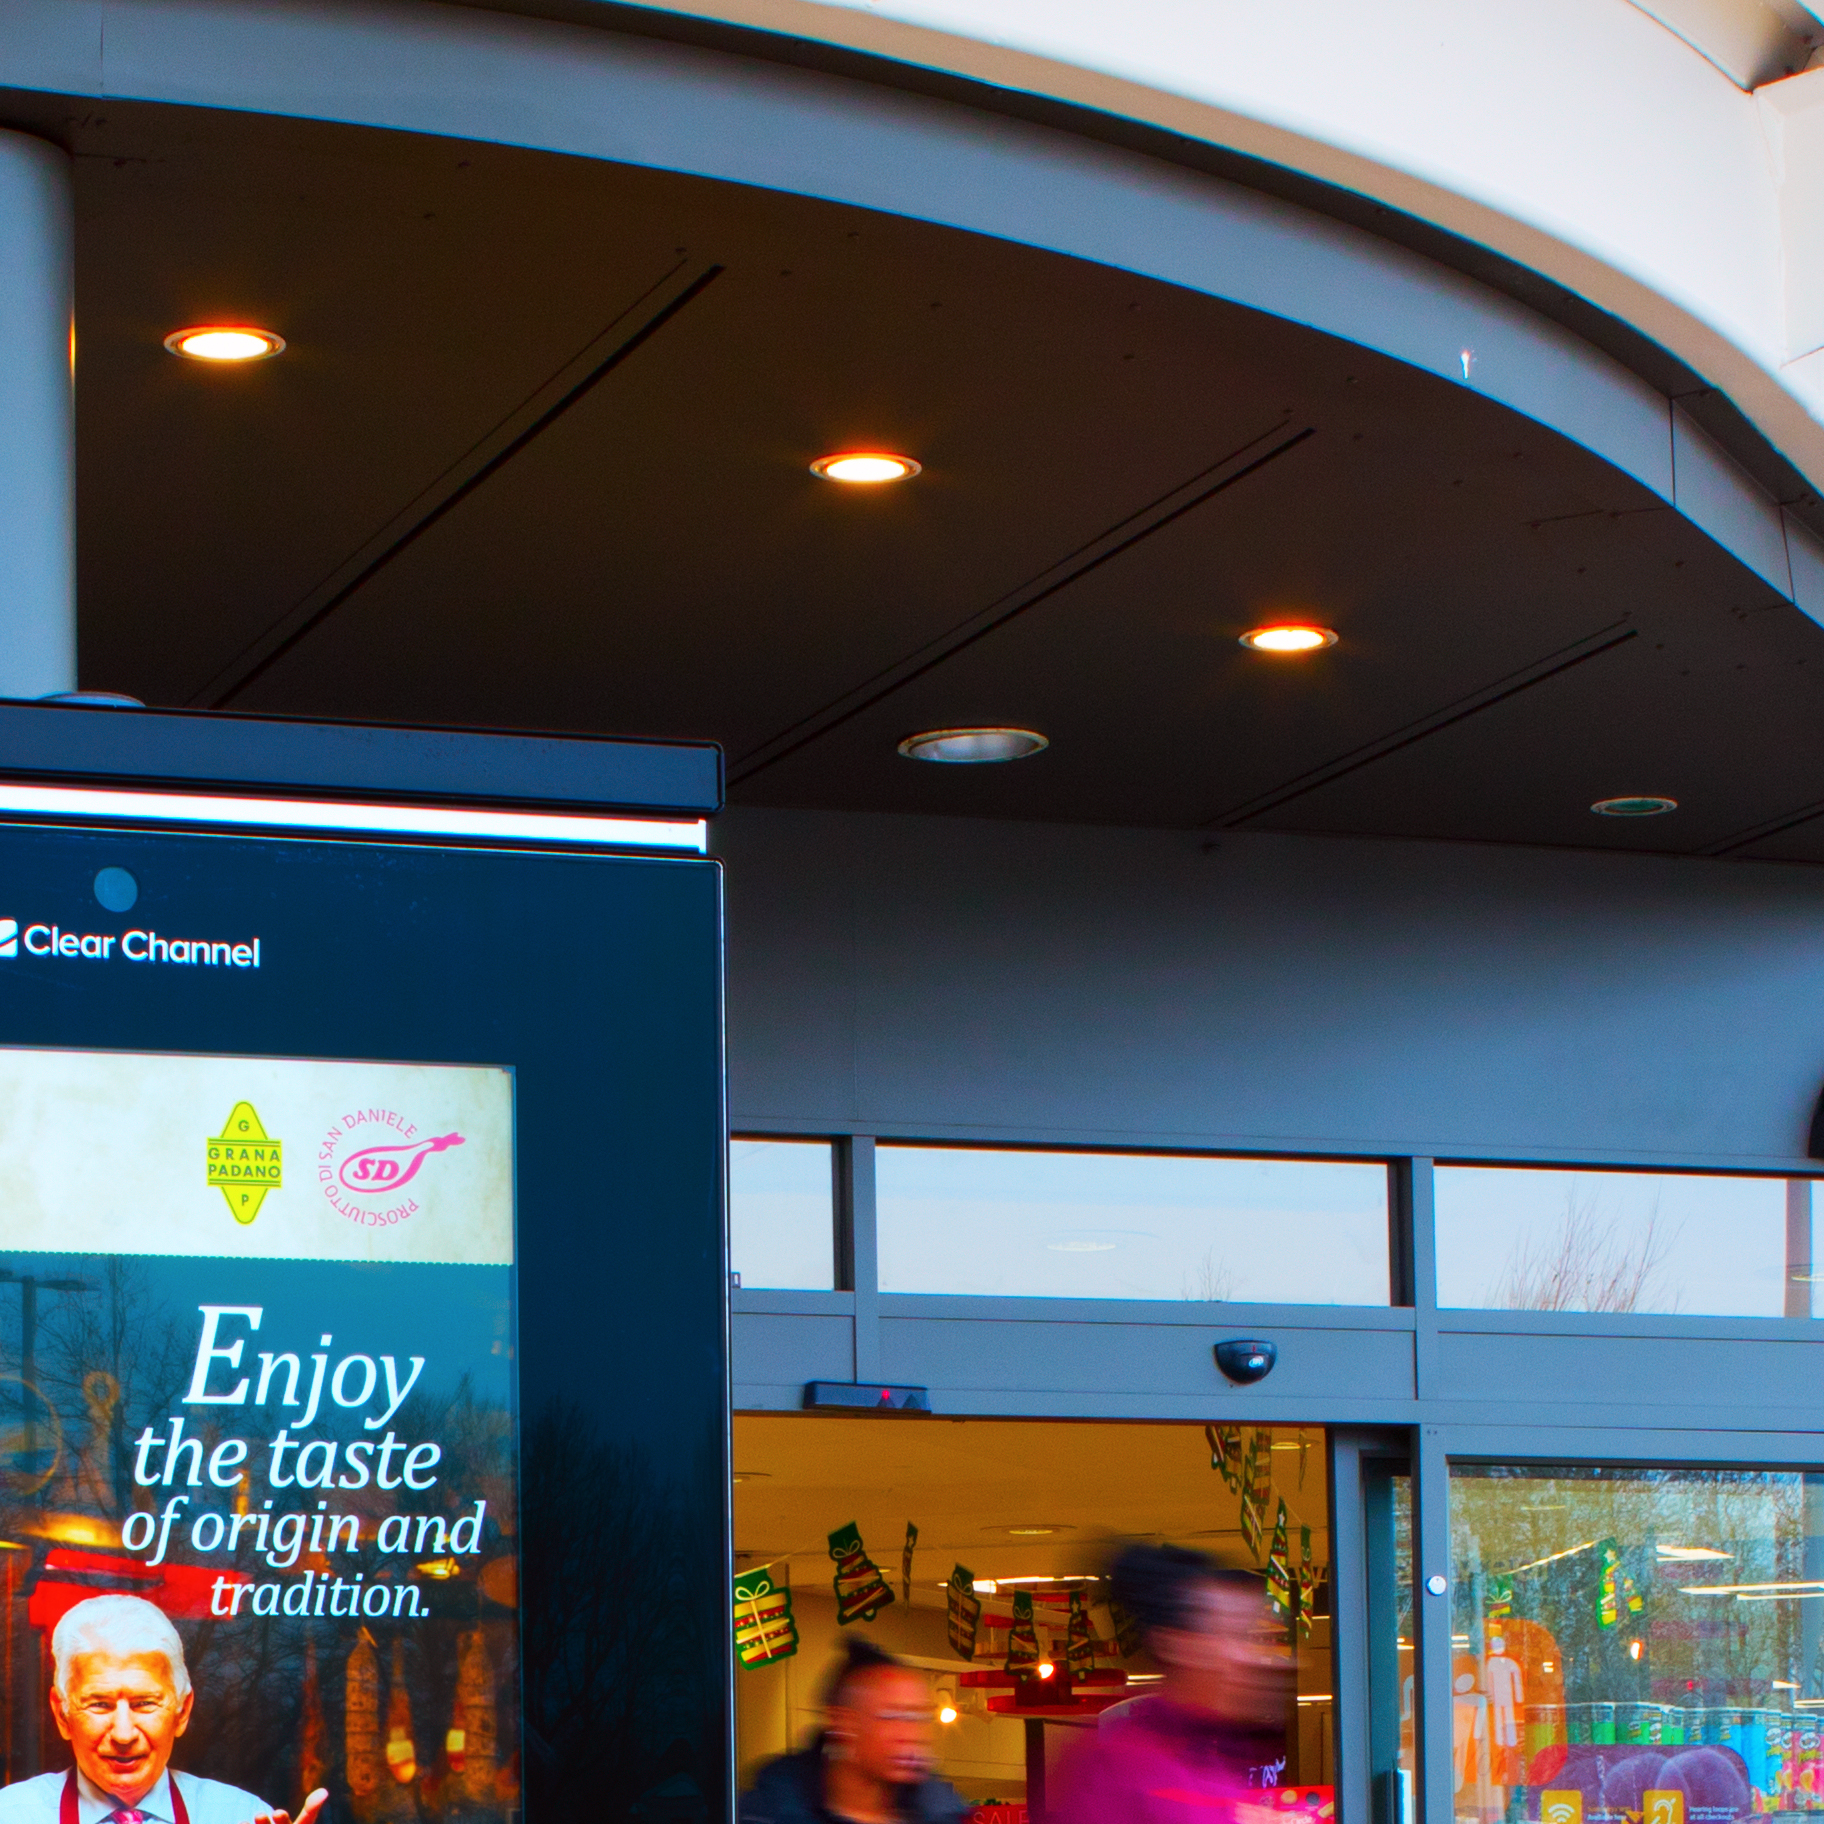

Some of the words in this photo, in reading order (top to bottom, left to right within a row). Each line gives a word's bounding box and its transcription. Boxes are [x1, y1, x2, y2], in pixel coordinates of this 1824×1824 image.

[24, 924, 116, 958] Clear
[122, 929, 260, 968] Channel
[238, 1120, 249, 1132] G
[342, 1108, 418, 1139] DANIELE
[208, 1148, 281, 1162] GRANA
[318, 1126, 343, 1160] SAN
[208, 1164, 281, 1178] PADANO
[318, 1164, 333, 1182] DI
[352, 1158, 400, 1181] SD
[241, 1193, 250, 1206] P
[324, 1185, 420, 1227] PROSCIUTTO
[182, 1305, 425, 1430] Enjoy
[133, 1416, 248, 1487] the
[268, 1429, 441, 1489] taste
[121, 1495, 190, 1566] of
[191, 1500, 360, 1568] origin
[377, 1500, 487, 1554] and
[210, 1569, 431, 1617] tradition.
